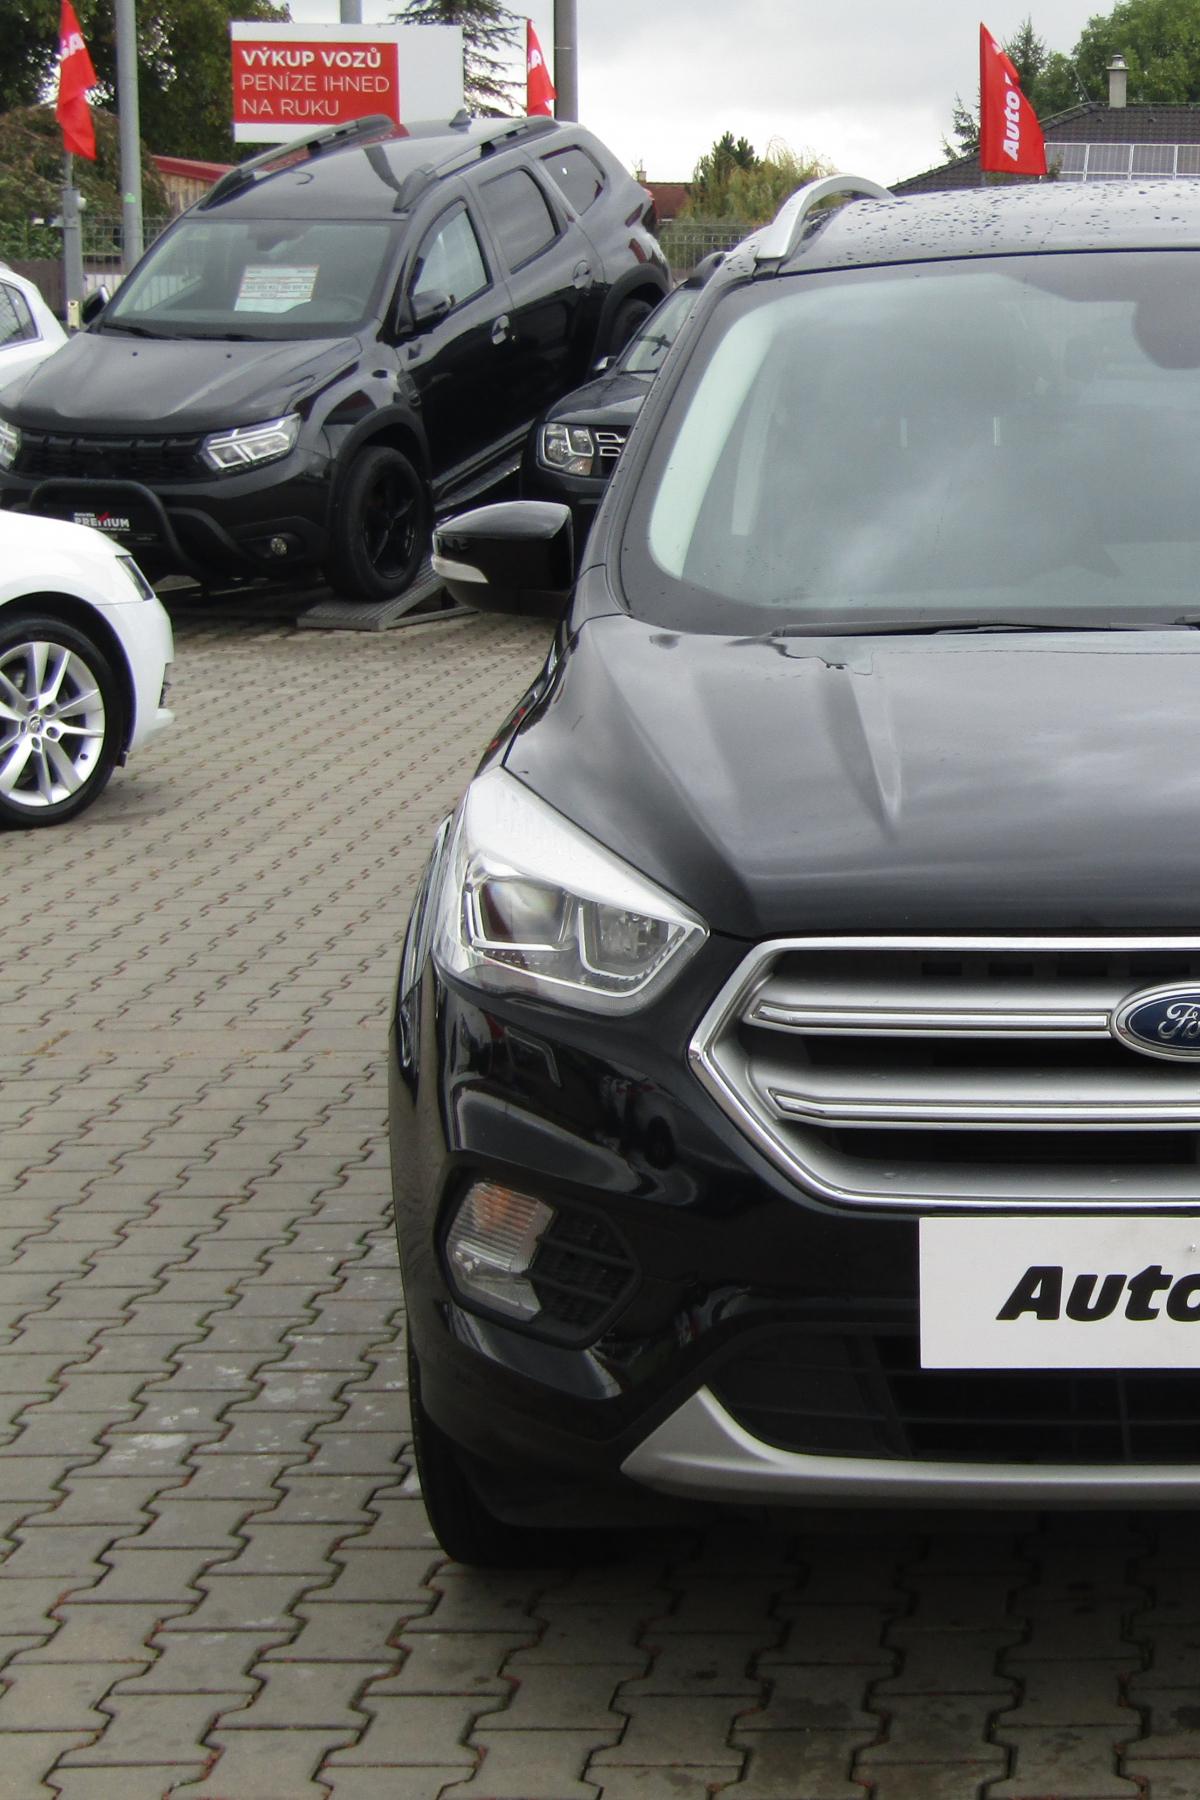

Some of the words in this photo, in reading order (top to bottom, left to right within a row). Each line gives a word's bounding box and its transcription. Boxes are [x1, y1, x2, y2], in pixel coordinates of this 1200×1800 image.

[242, 47, 315, 67] VÝKUP
[321, 47, 382, 68] VOZŮ
[241, 72, 317, 92] PENÍZE
[324, 75, 390, 93] IHNED
[242, 99, 273, 115] NA
[280, 99, 339, 116] RUKU
[1003, 91, 1020, 161] Auto
